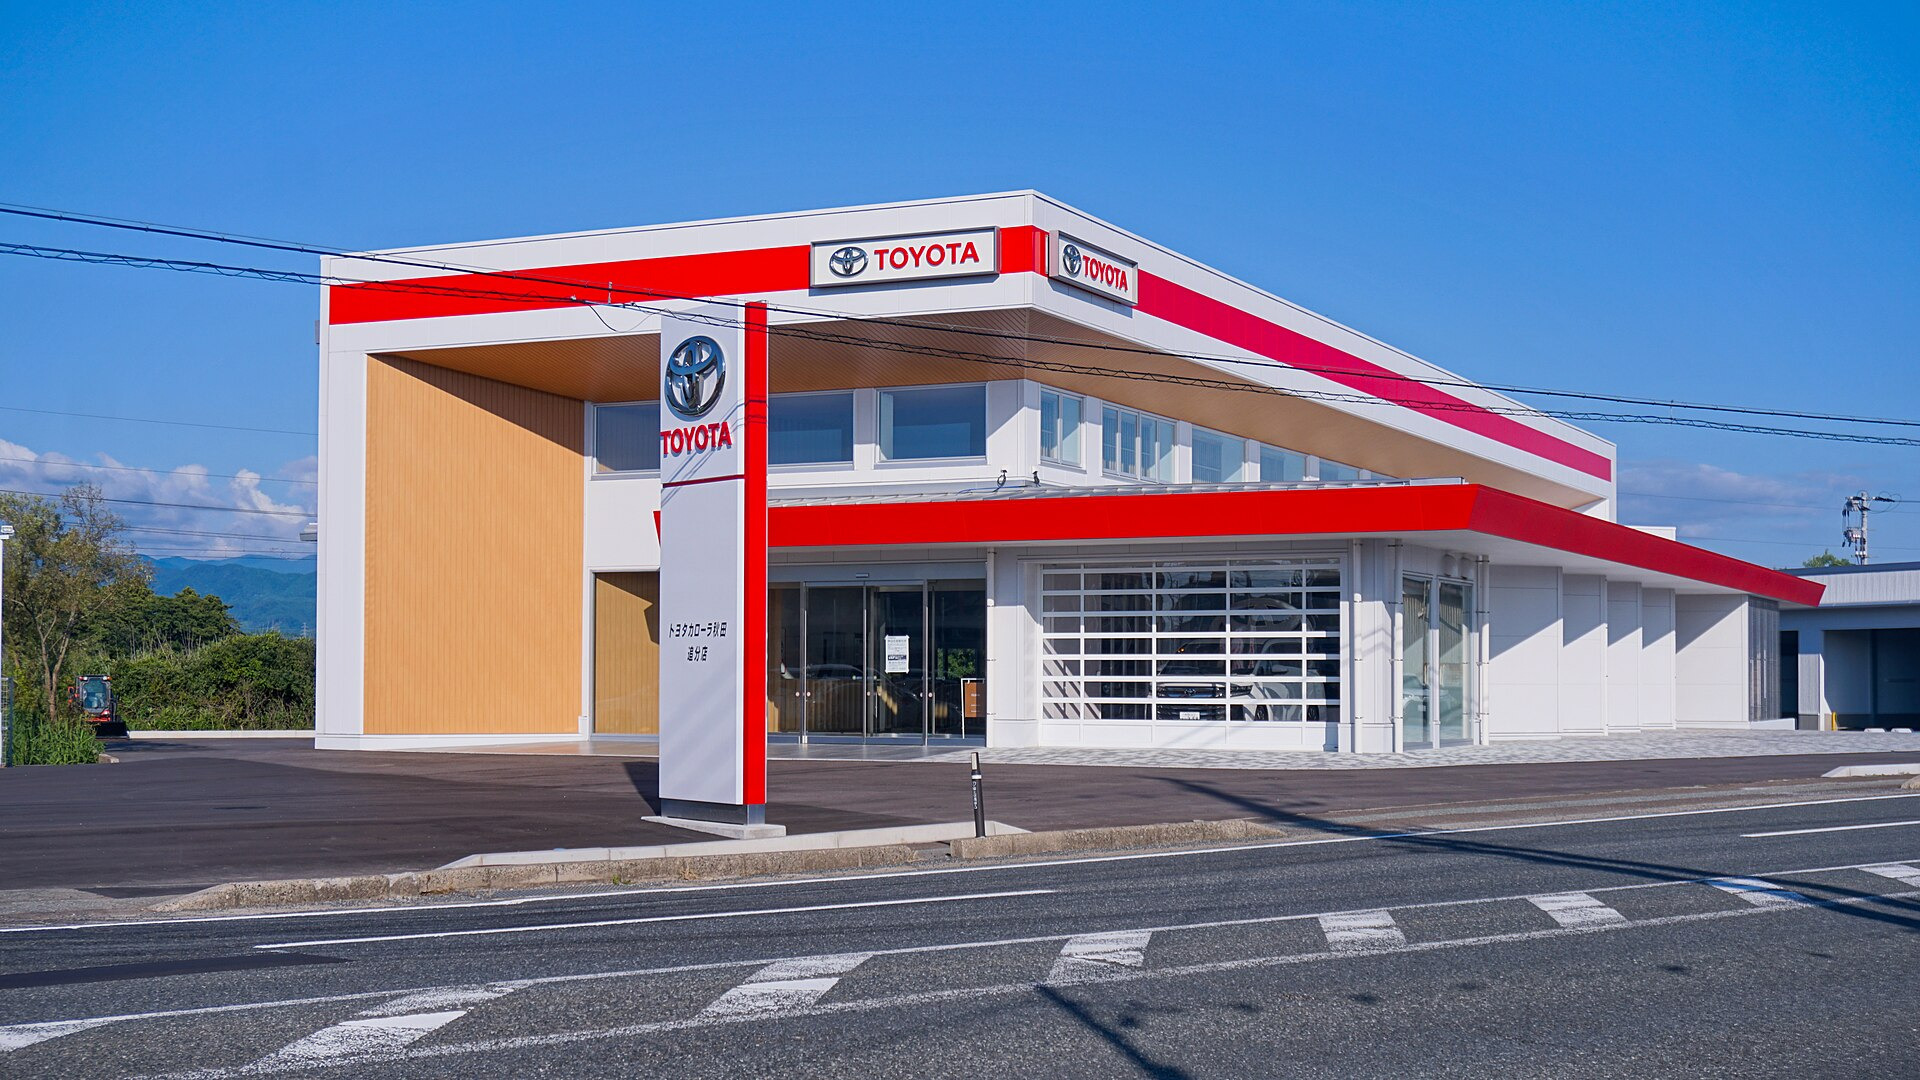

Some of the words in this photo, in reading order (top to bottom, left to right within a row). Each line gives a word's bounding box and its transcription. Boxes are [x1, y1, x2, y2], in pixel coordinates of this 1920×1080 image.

[874, 241, 979, 271] TOYOTA
[1083, 255, 1128, 291] TOYOTA
[660, 421, 732, 455] TOYOTA
[669, 622, 727, 638] トヨタカローラ秋田
[687, 645, 708, 662] 追分店
